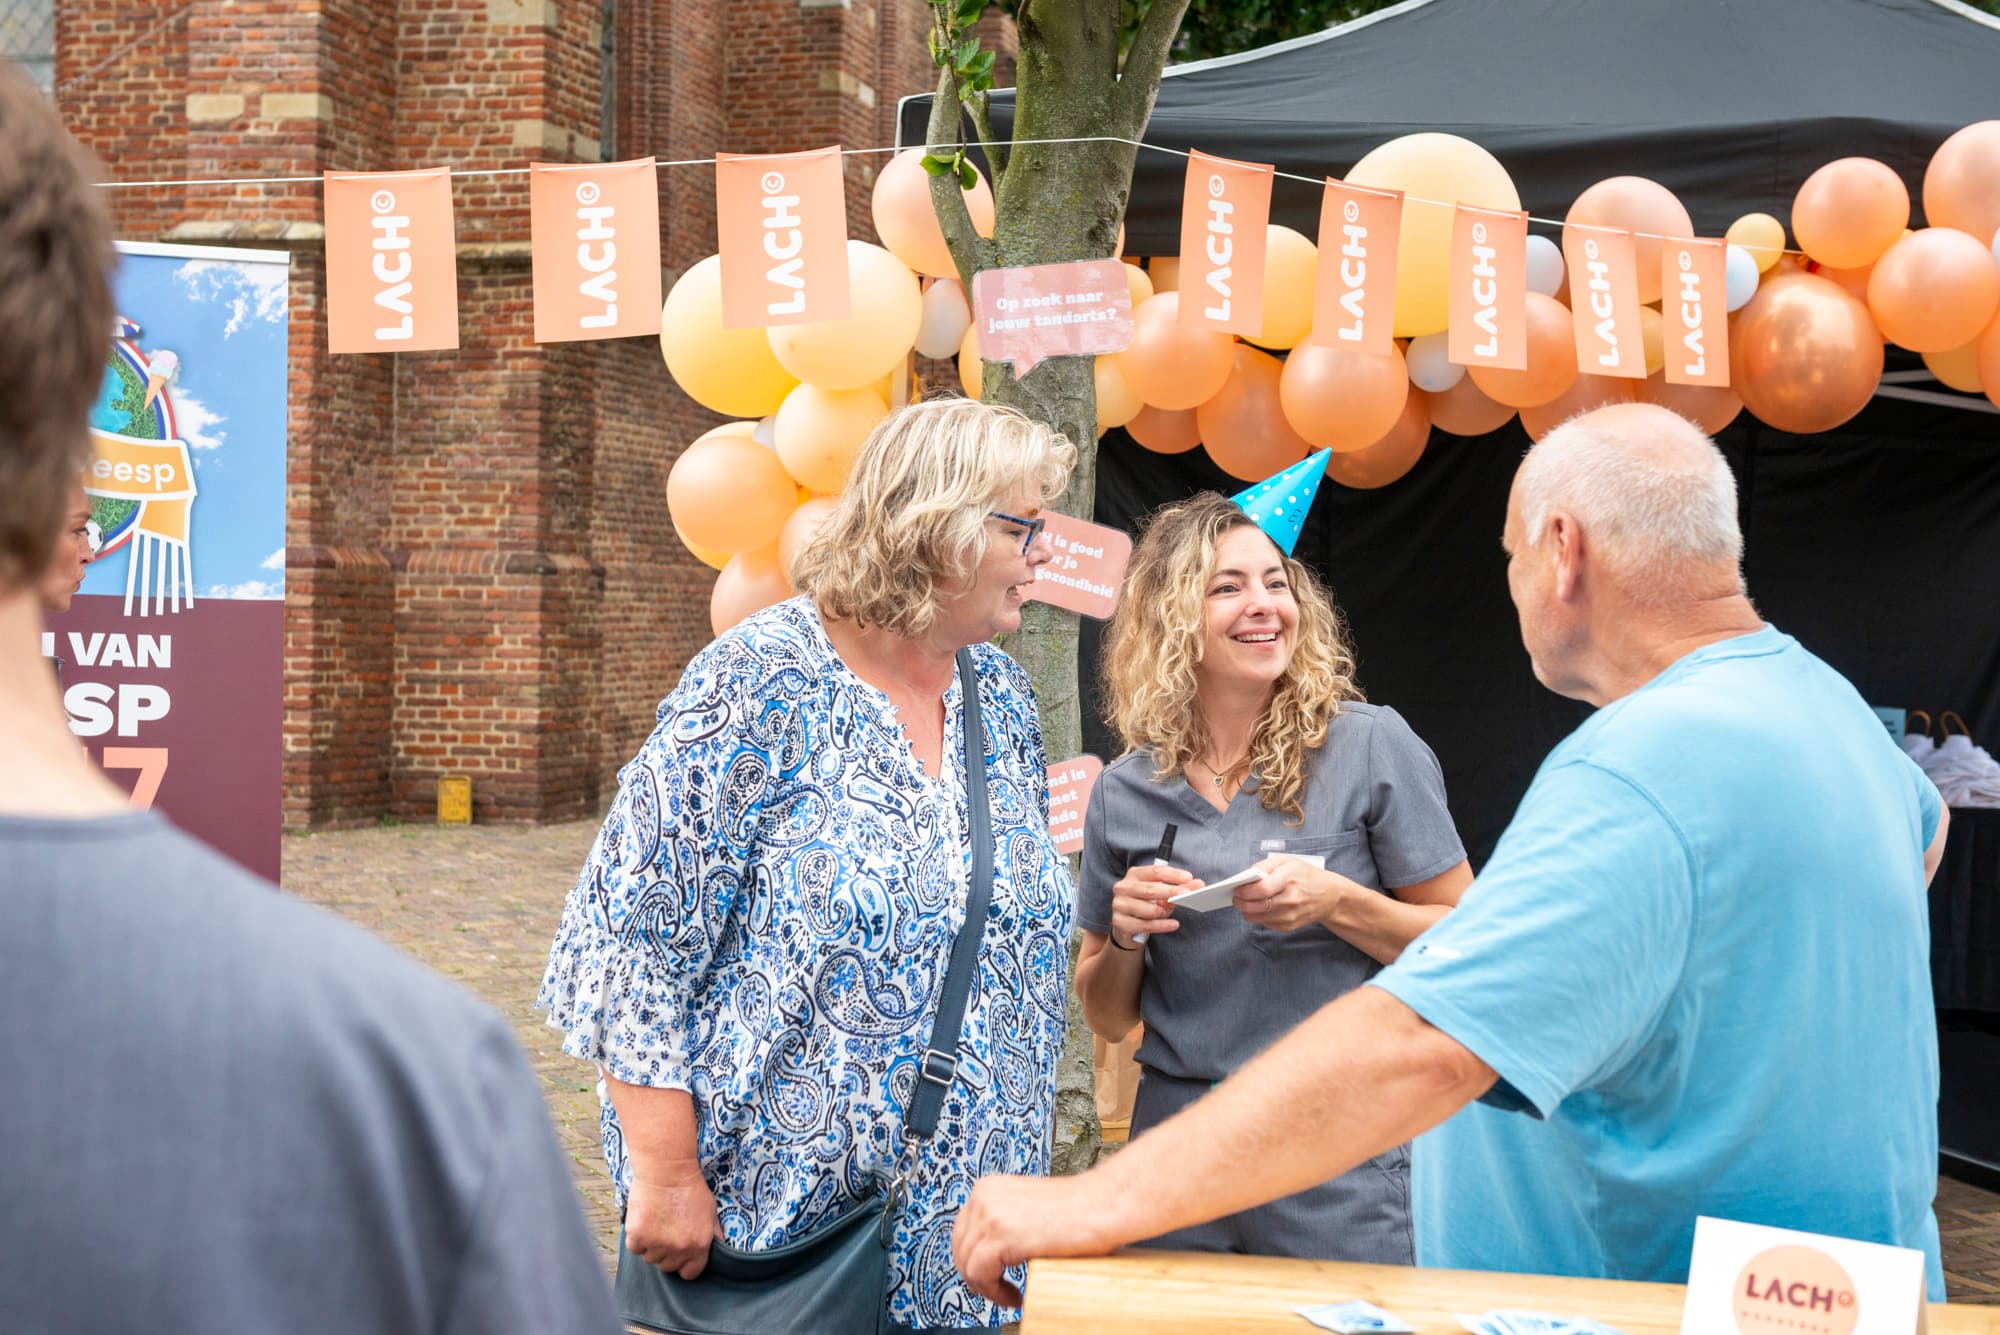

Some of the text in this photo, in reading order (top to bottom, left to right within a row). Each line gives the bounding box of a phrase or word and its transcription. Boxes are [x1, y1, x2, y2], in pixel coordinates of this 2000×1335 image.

[371, 215, 413, 341] LACH
[577, 206, 617, 328] LACH
[762, 195, 806, 315] LACH
[1205, 199, 1234, 322] LACH
[1338, 224, 1368, 342] LACH
[988, 308, 1117, 335] jouw tandarts?
[996, 291, 1104, 313] Op zoek naar
[1472, 245, 1498, 358] LACH
[1586, 261, 1620, 368] LACH
[1679, 272, 1706, 376] LACH
[92, 459, 176, 492] eesp
[1054, 533, 1068, 549] is
[67, 632, 172, 669] VAN
[62, 682, 171, 738] SP
[1070, 769, 1087, 782] in
[1746, 1273, 1834, 1314] LACH
